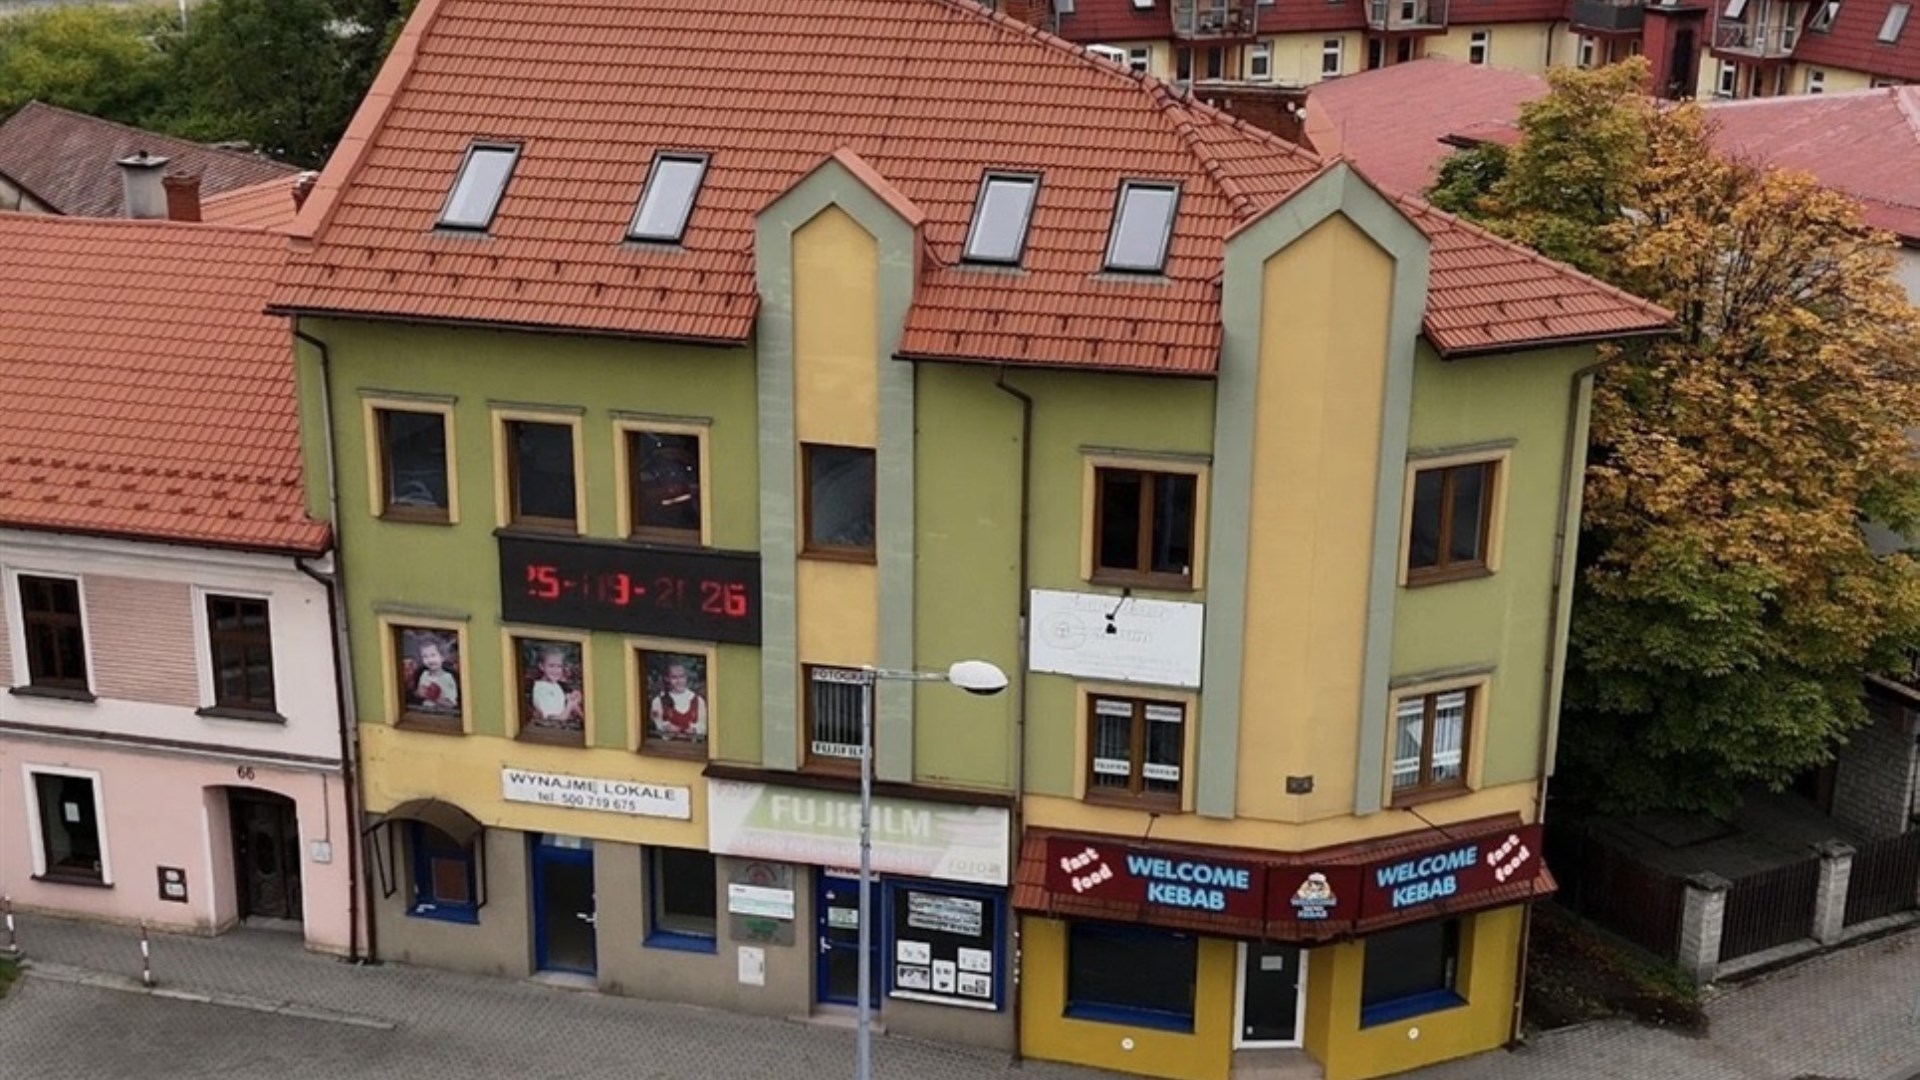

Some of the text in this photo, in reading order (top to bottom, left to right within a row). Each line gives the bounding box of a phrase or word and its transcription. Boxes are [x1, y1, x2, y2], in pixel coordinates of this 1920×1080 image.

[562, 792, 585, 806] 500
[586, 794, 610, 809] 719
[612, 797, 636, 812] 675
[604, 783, 676, 801] LOKALE
[771, 794, 932, 837] FUJIFILM
[1060, 847, 1100, 873] fast
[1377, 846, 1478, 887] WELCOME
[1487, 834, 1520, 867] fast
[1495, 845, 1530, 882] food
[1071, 863, 1113, 893] food
[1126, 855, 1249, 888] WELCOME
[1148, 882, 1225, 910] KEBAB
[1392, 875, 1457, 908] KEBAB
